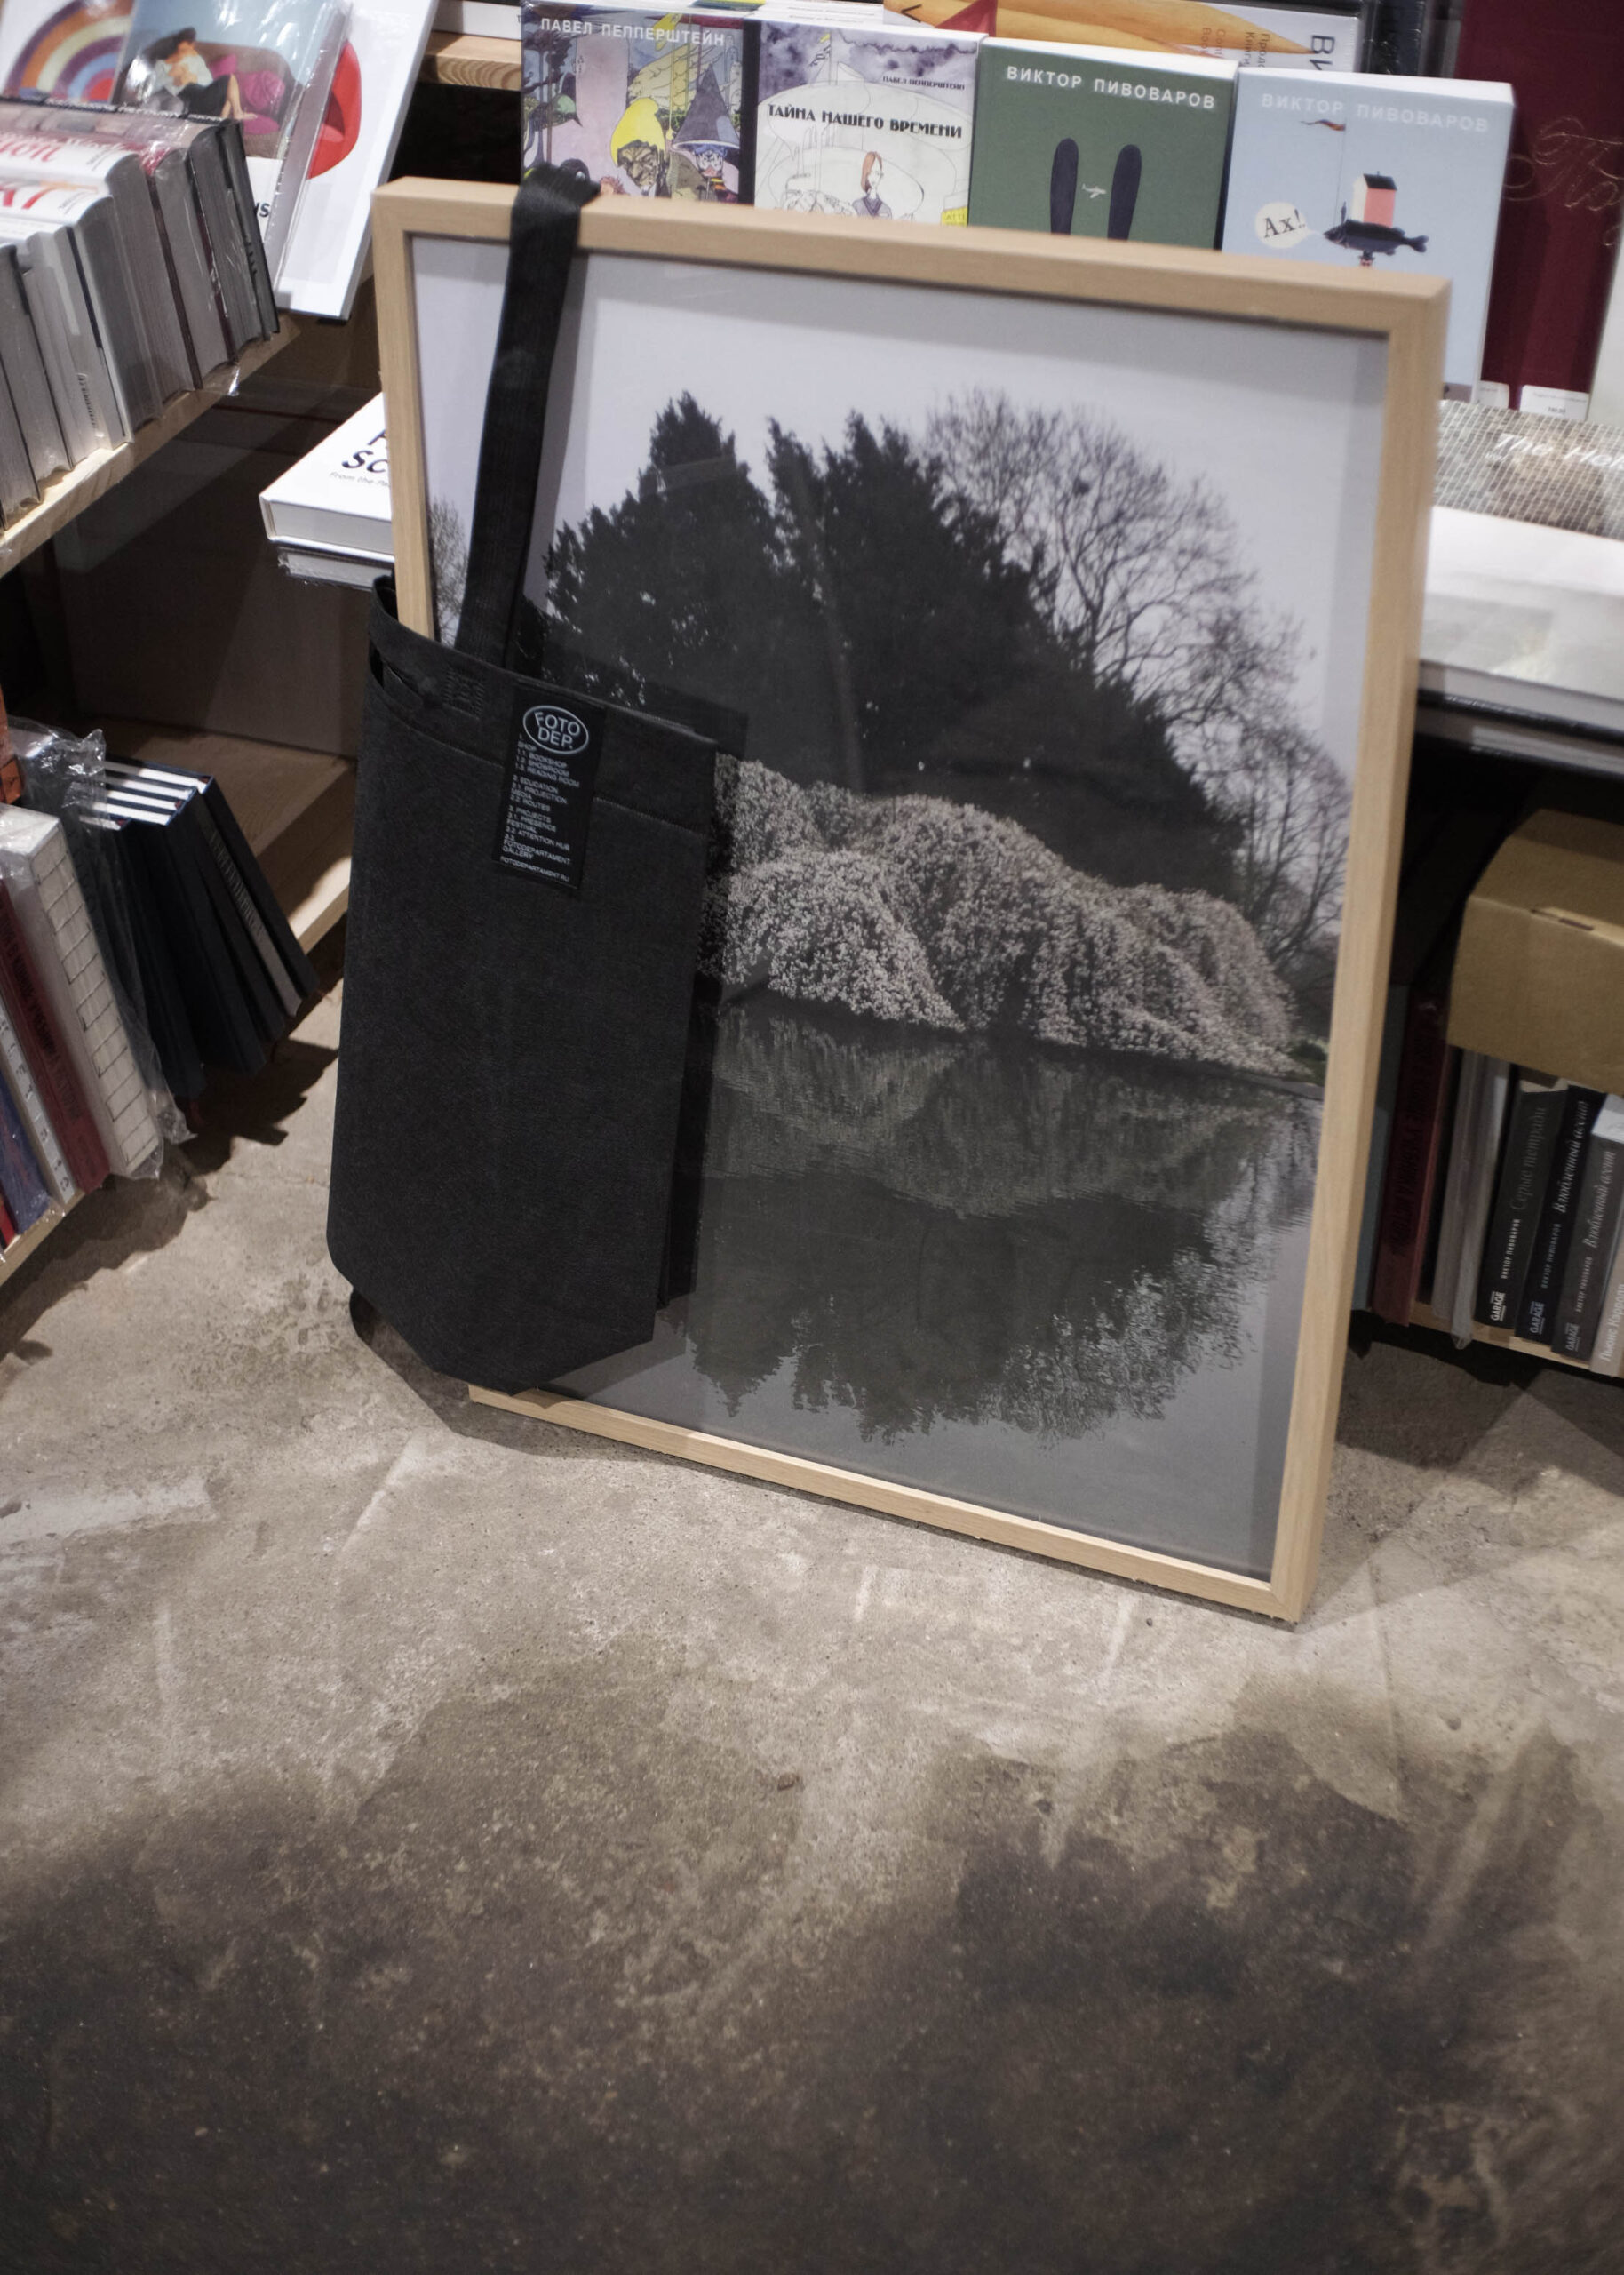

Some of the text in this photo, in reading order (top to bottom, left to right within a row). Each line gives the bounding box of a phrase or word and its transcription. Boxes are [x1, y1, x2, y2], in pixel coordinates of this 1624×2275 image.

[541, 18, 593, 35] ПАВЕЛ
[601, 23, 725, 46] ПЕППЕРШТЕЙН
[1007, 66, 1215, 109] ВИКТОР ПИВОВАРОВ
[768, 103, 962, 139] ТАЙНА НАШЕГО ВРЕМЕНИ
[1262, 93, 1489, 132] ВИКТОР ПИВОВАРОВ
[534, 711, 581, 736] FOTO
[538, 726, 574, 750] DEP.
[558, 777, 580, 788] ROOM
[1554, 1141, 1581, 1214] Влюбленный
[1582, 1186, 1608, 1249] Влюбленный
[1490, 1291, 1506, 1321] GARAGE
[1530, 1301, 1546, 1333] GARAGE
[1566, 1323, 1580, 1352] GARAGE
